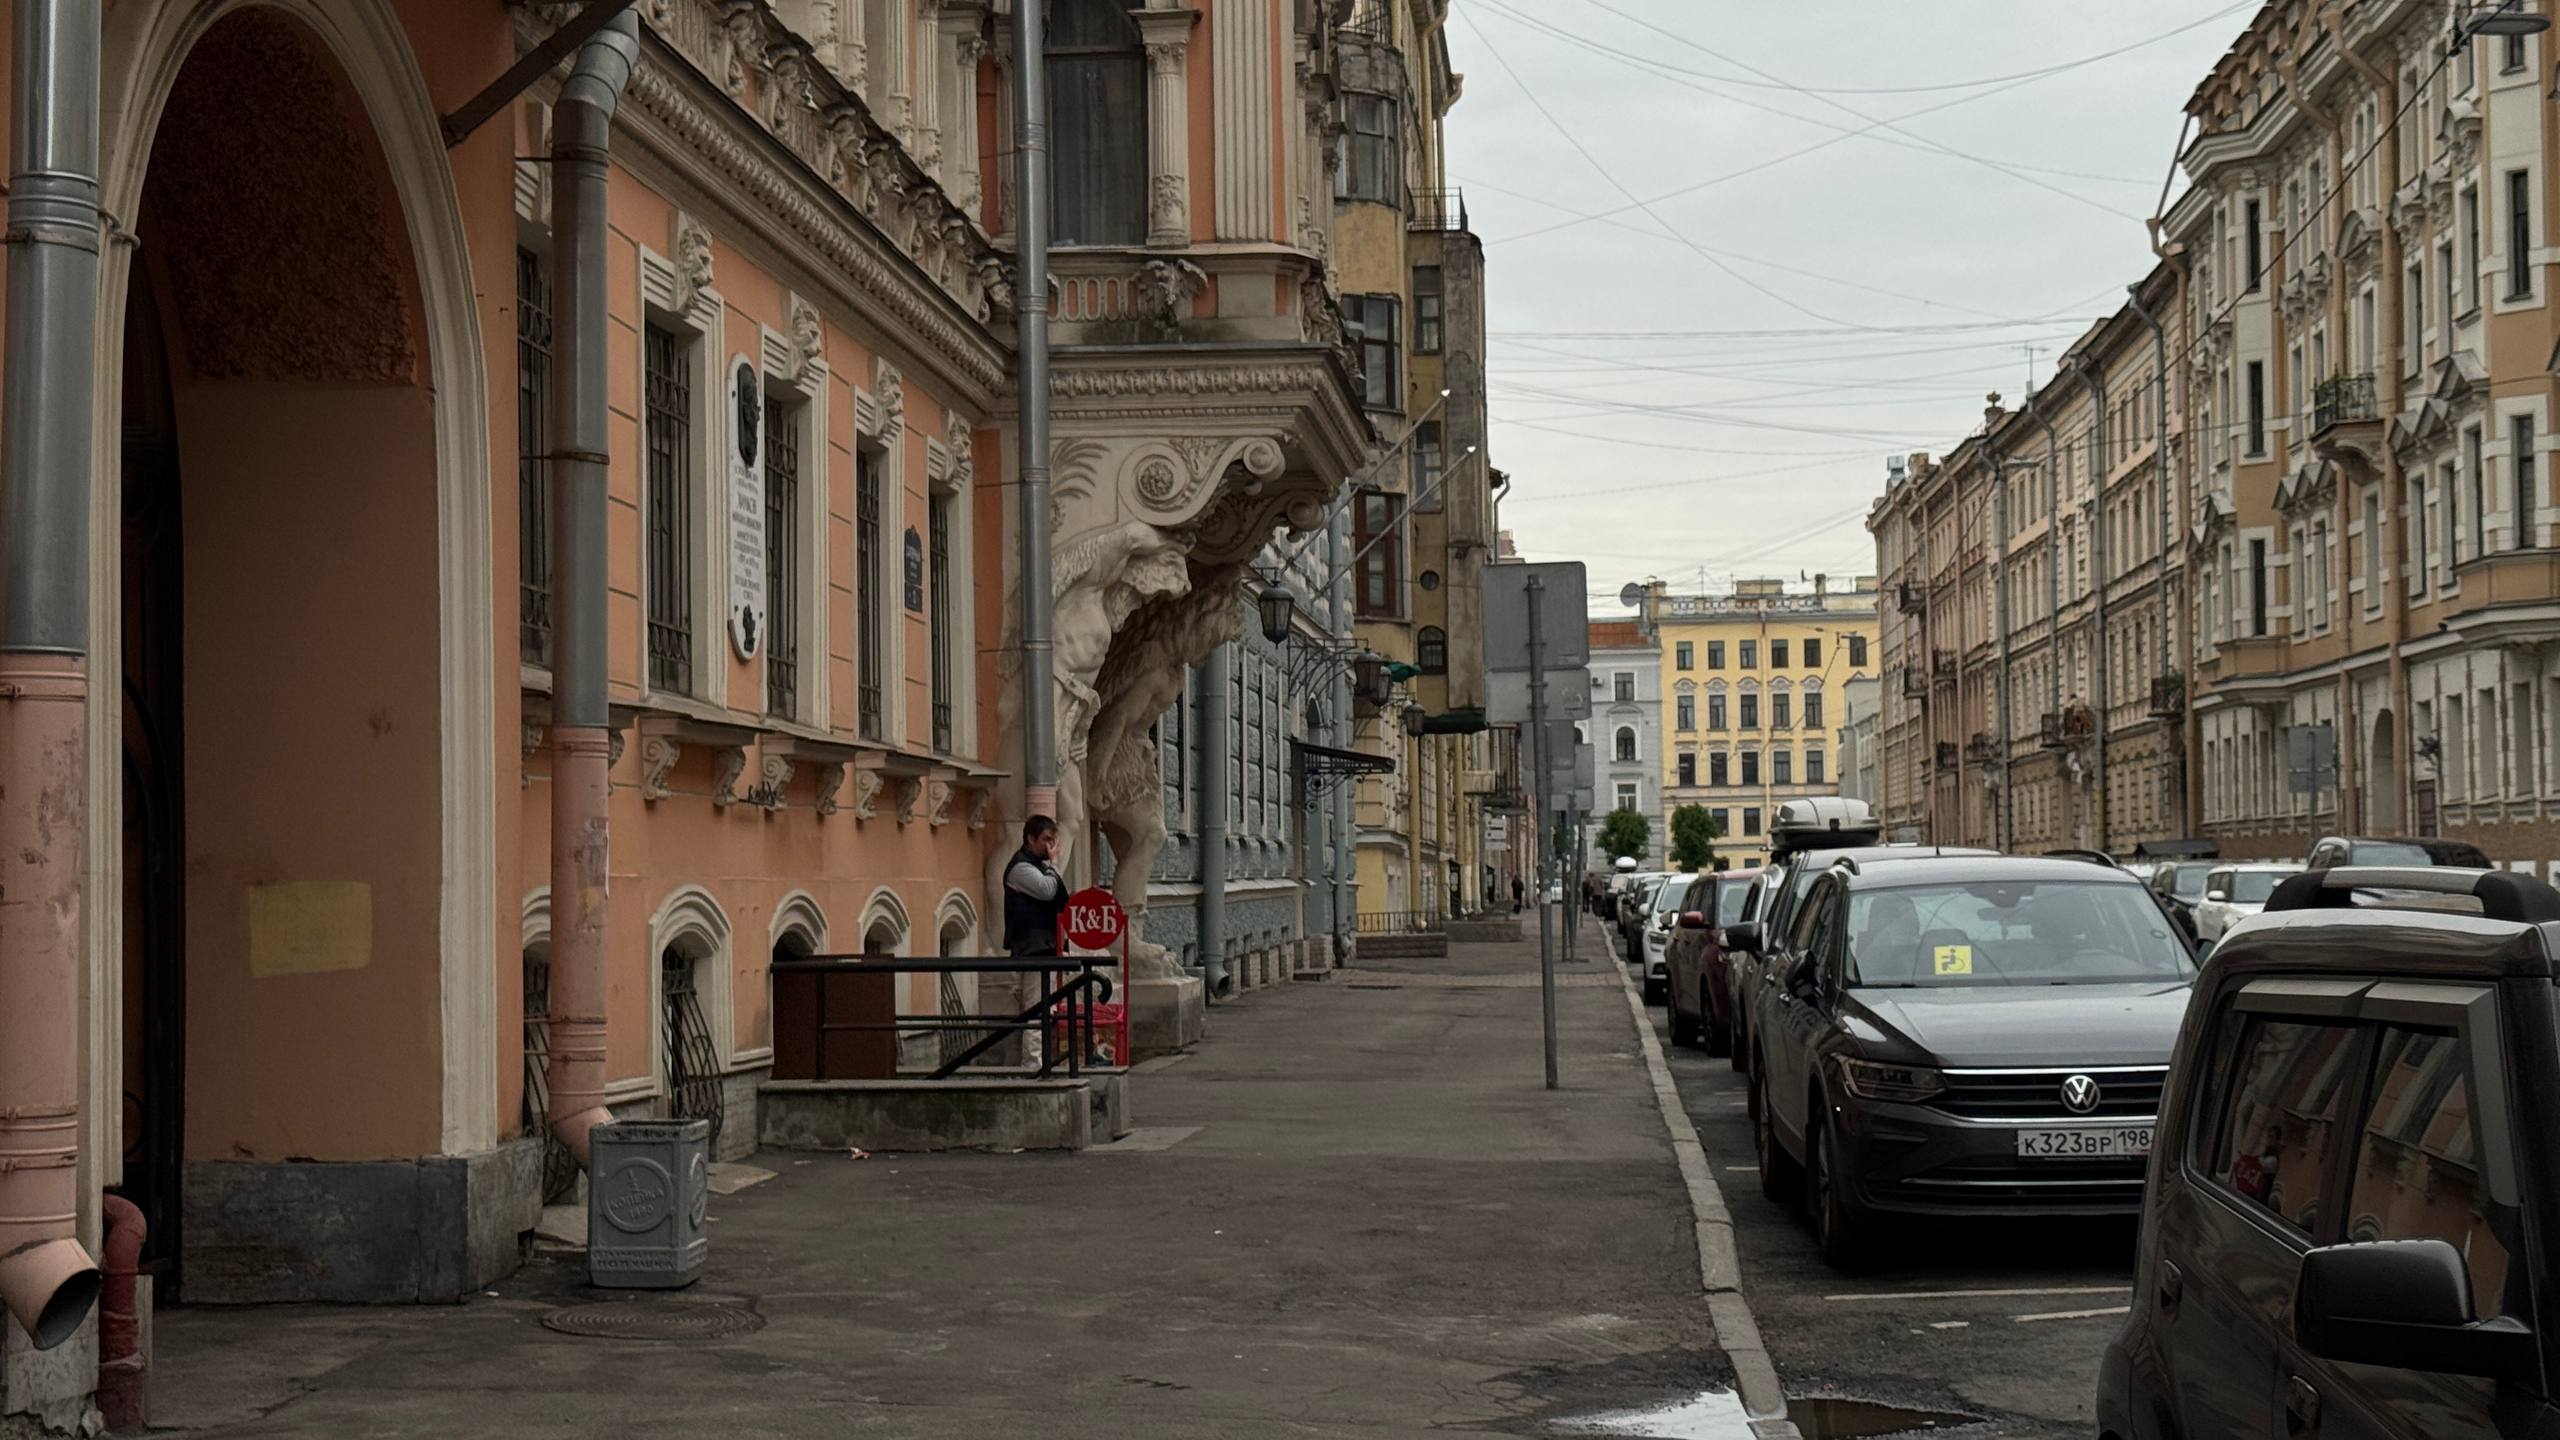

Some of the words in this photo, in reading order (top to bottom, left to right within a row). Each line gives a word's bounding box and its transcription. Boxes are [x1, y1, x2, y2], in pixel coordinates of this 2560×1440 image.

[1069, 905, 1117, 934] К&Б
[2024, 1132, 2112, 1154] К323ВР
[2118, 1130, 2150, 1147] 198
